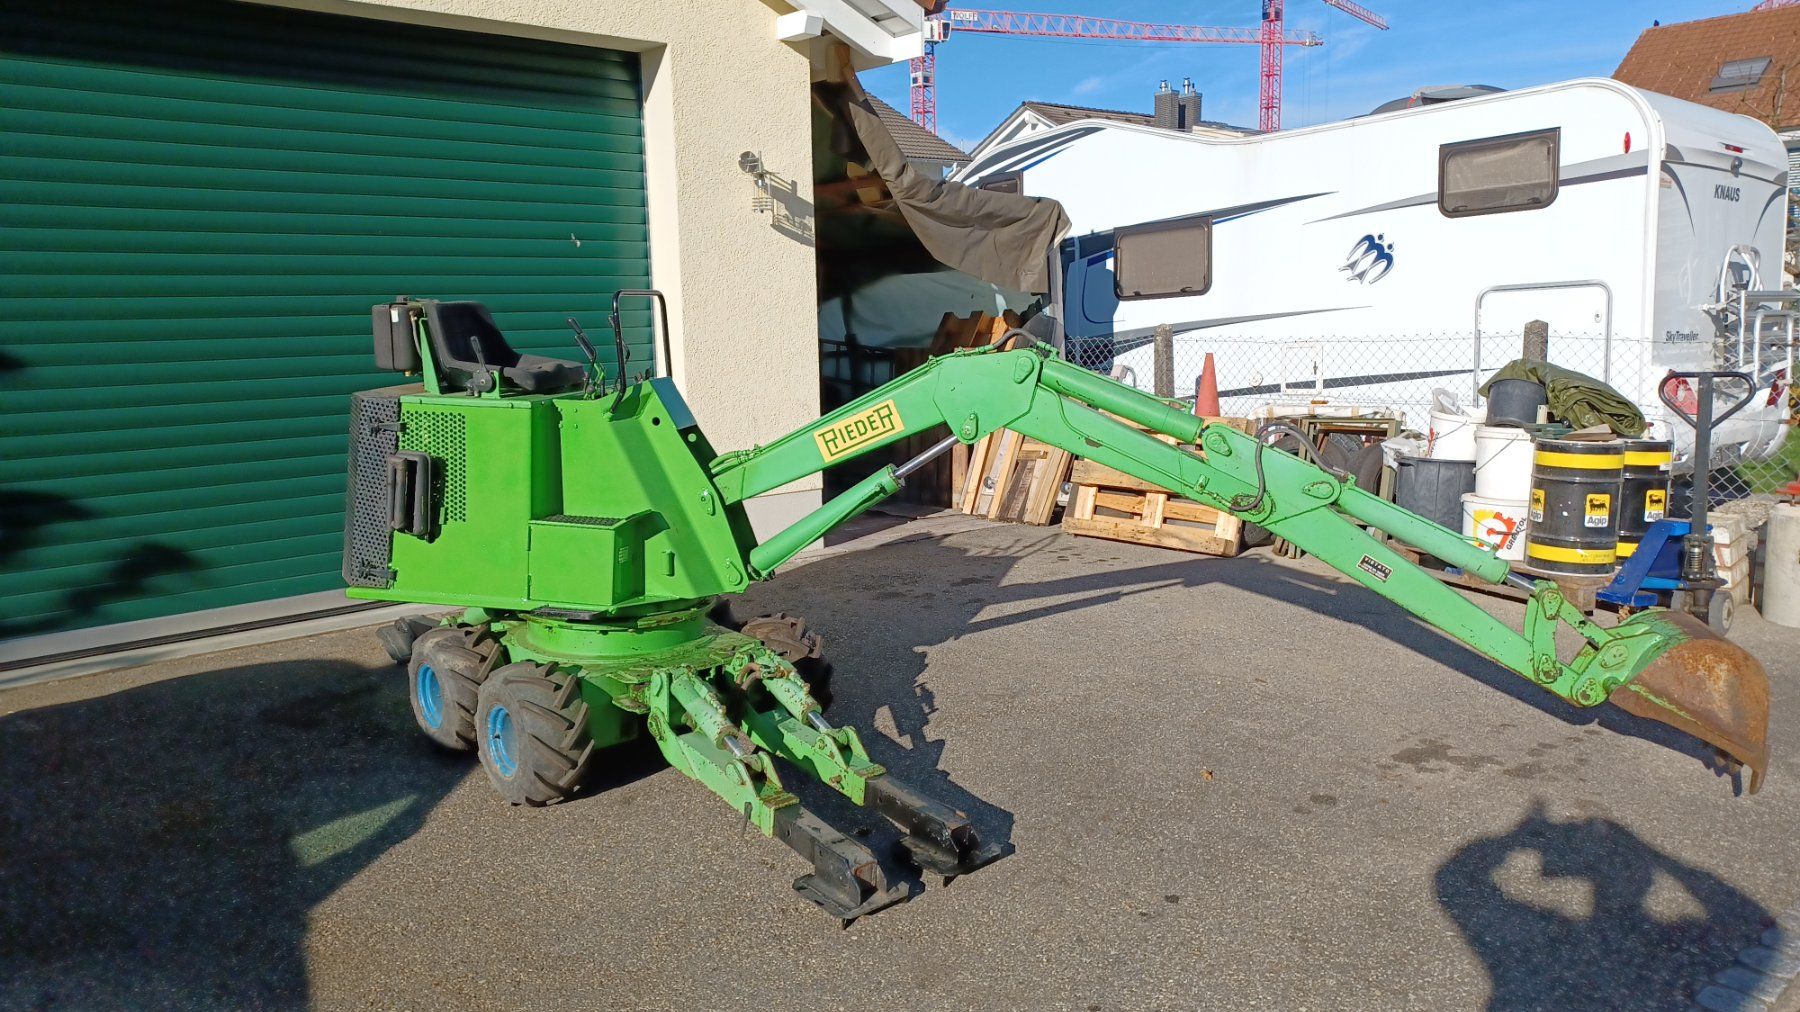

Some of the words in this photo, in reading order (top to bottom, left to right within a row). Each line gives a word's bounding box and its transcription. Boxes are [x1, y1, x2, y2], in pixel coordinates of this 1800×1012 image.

[1714, 184, 1740, 202] KNAUS
[818, 404, 895, 456] RIEDER
[1587, 516, 1607, 526] Agip
